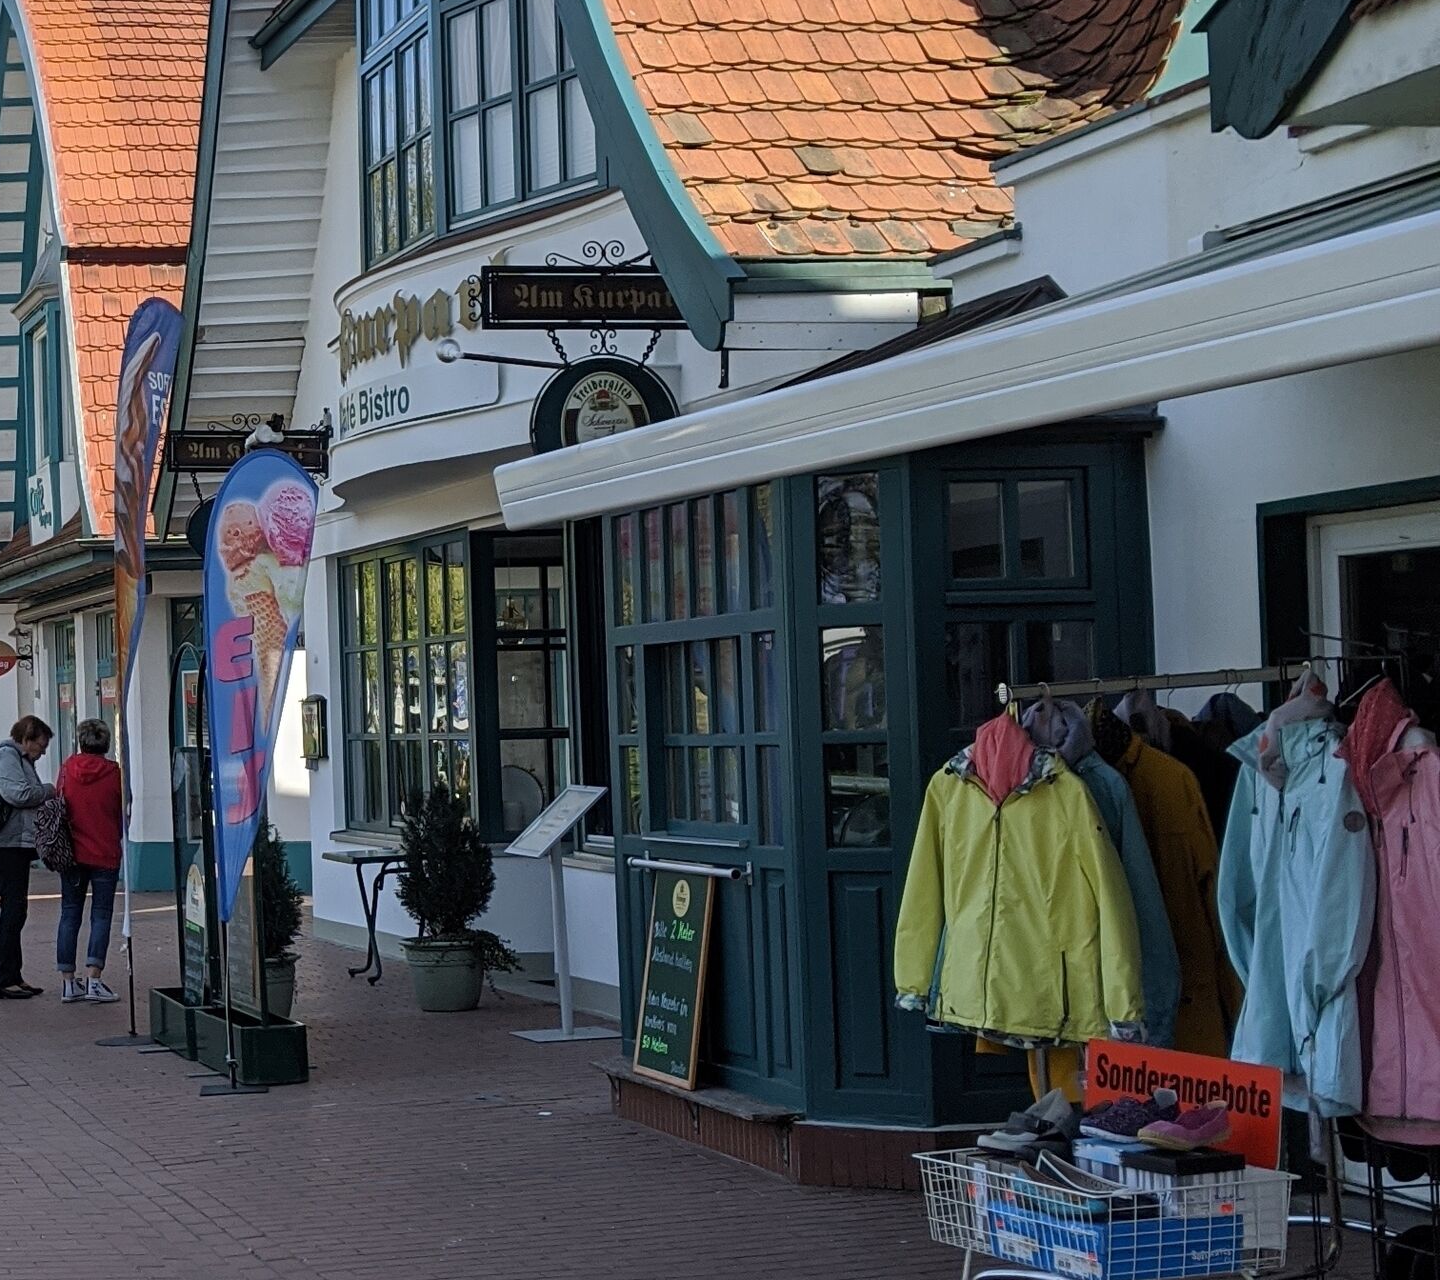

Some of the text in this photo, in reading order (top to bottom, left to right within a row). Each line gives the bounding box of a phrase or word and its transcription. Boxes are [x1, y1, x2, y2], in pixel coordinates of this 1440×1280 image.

[513, 283, 673, 315] Am Kurpar
[359, 384, 410, 426] Bistro
[188, 441, 220, 460] Am
[214, 615, 266, 826] EIS
[669, 919, 677, 940] 2
[677, 920, 696, 941] Meter
[1096, 1053, 1272, 1118] Sonderangebote
